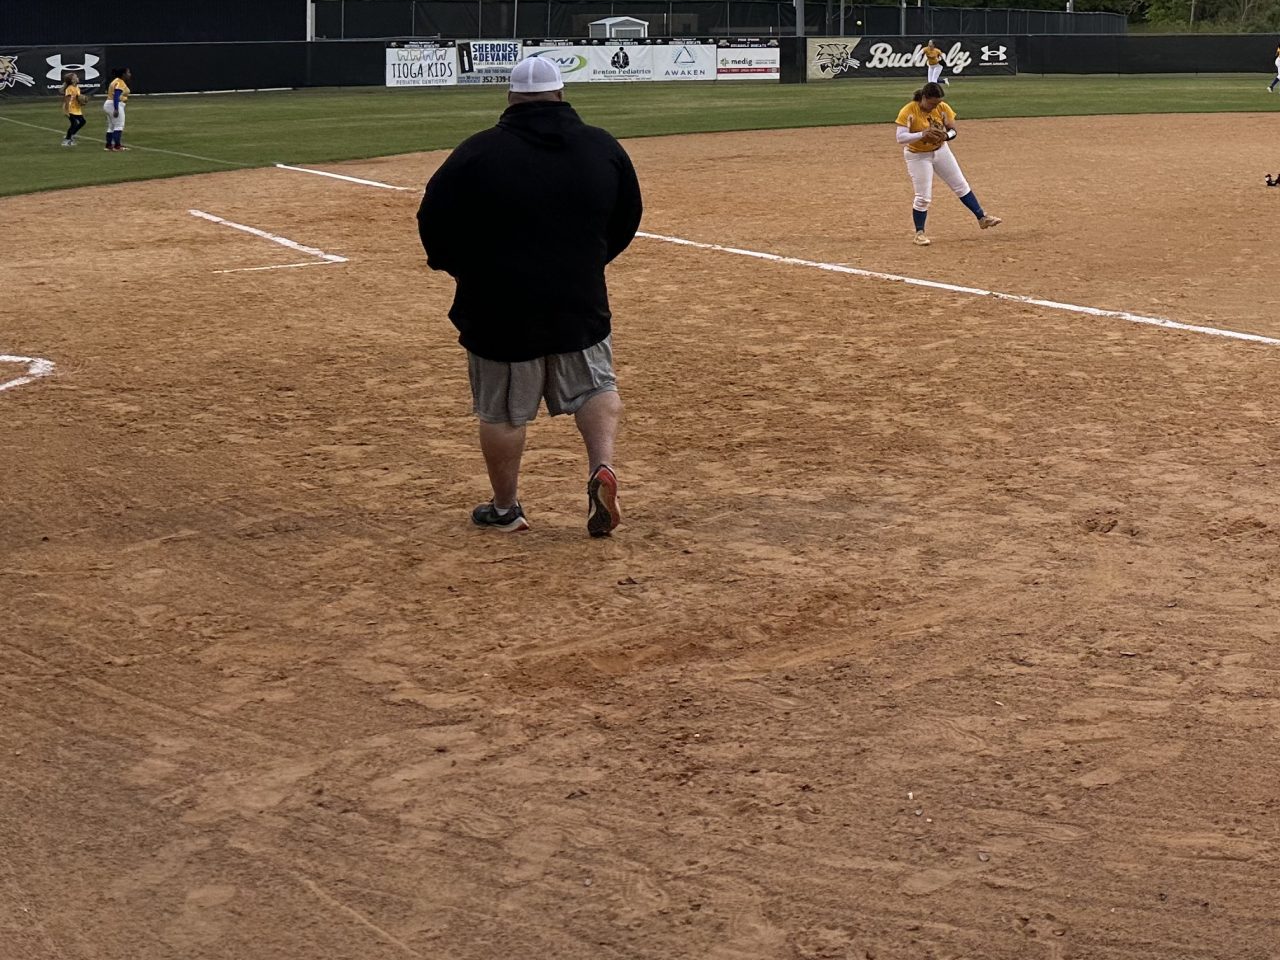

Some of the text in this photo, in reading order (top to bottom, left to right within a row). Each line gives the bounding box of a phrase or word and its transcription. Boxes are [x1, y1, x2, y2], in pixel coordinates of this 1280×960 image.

[472, 43, 518, 53] SHEROUSE
[391, 62, 453, 78] TIOGA KIDS
